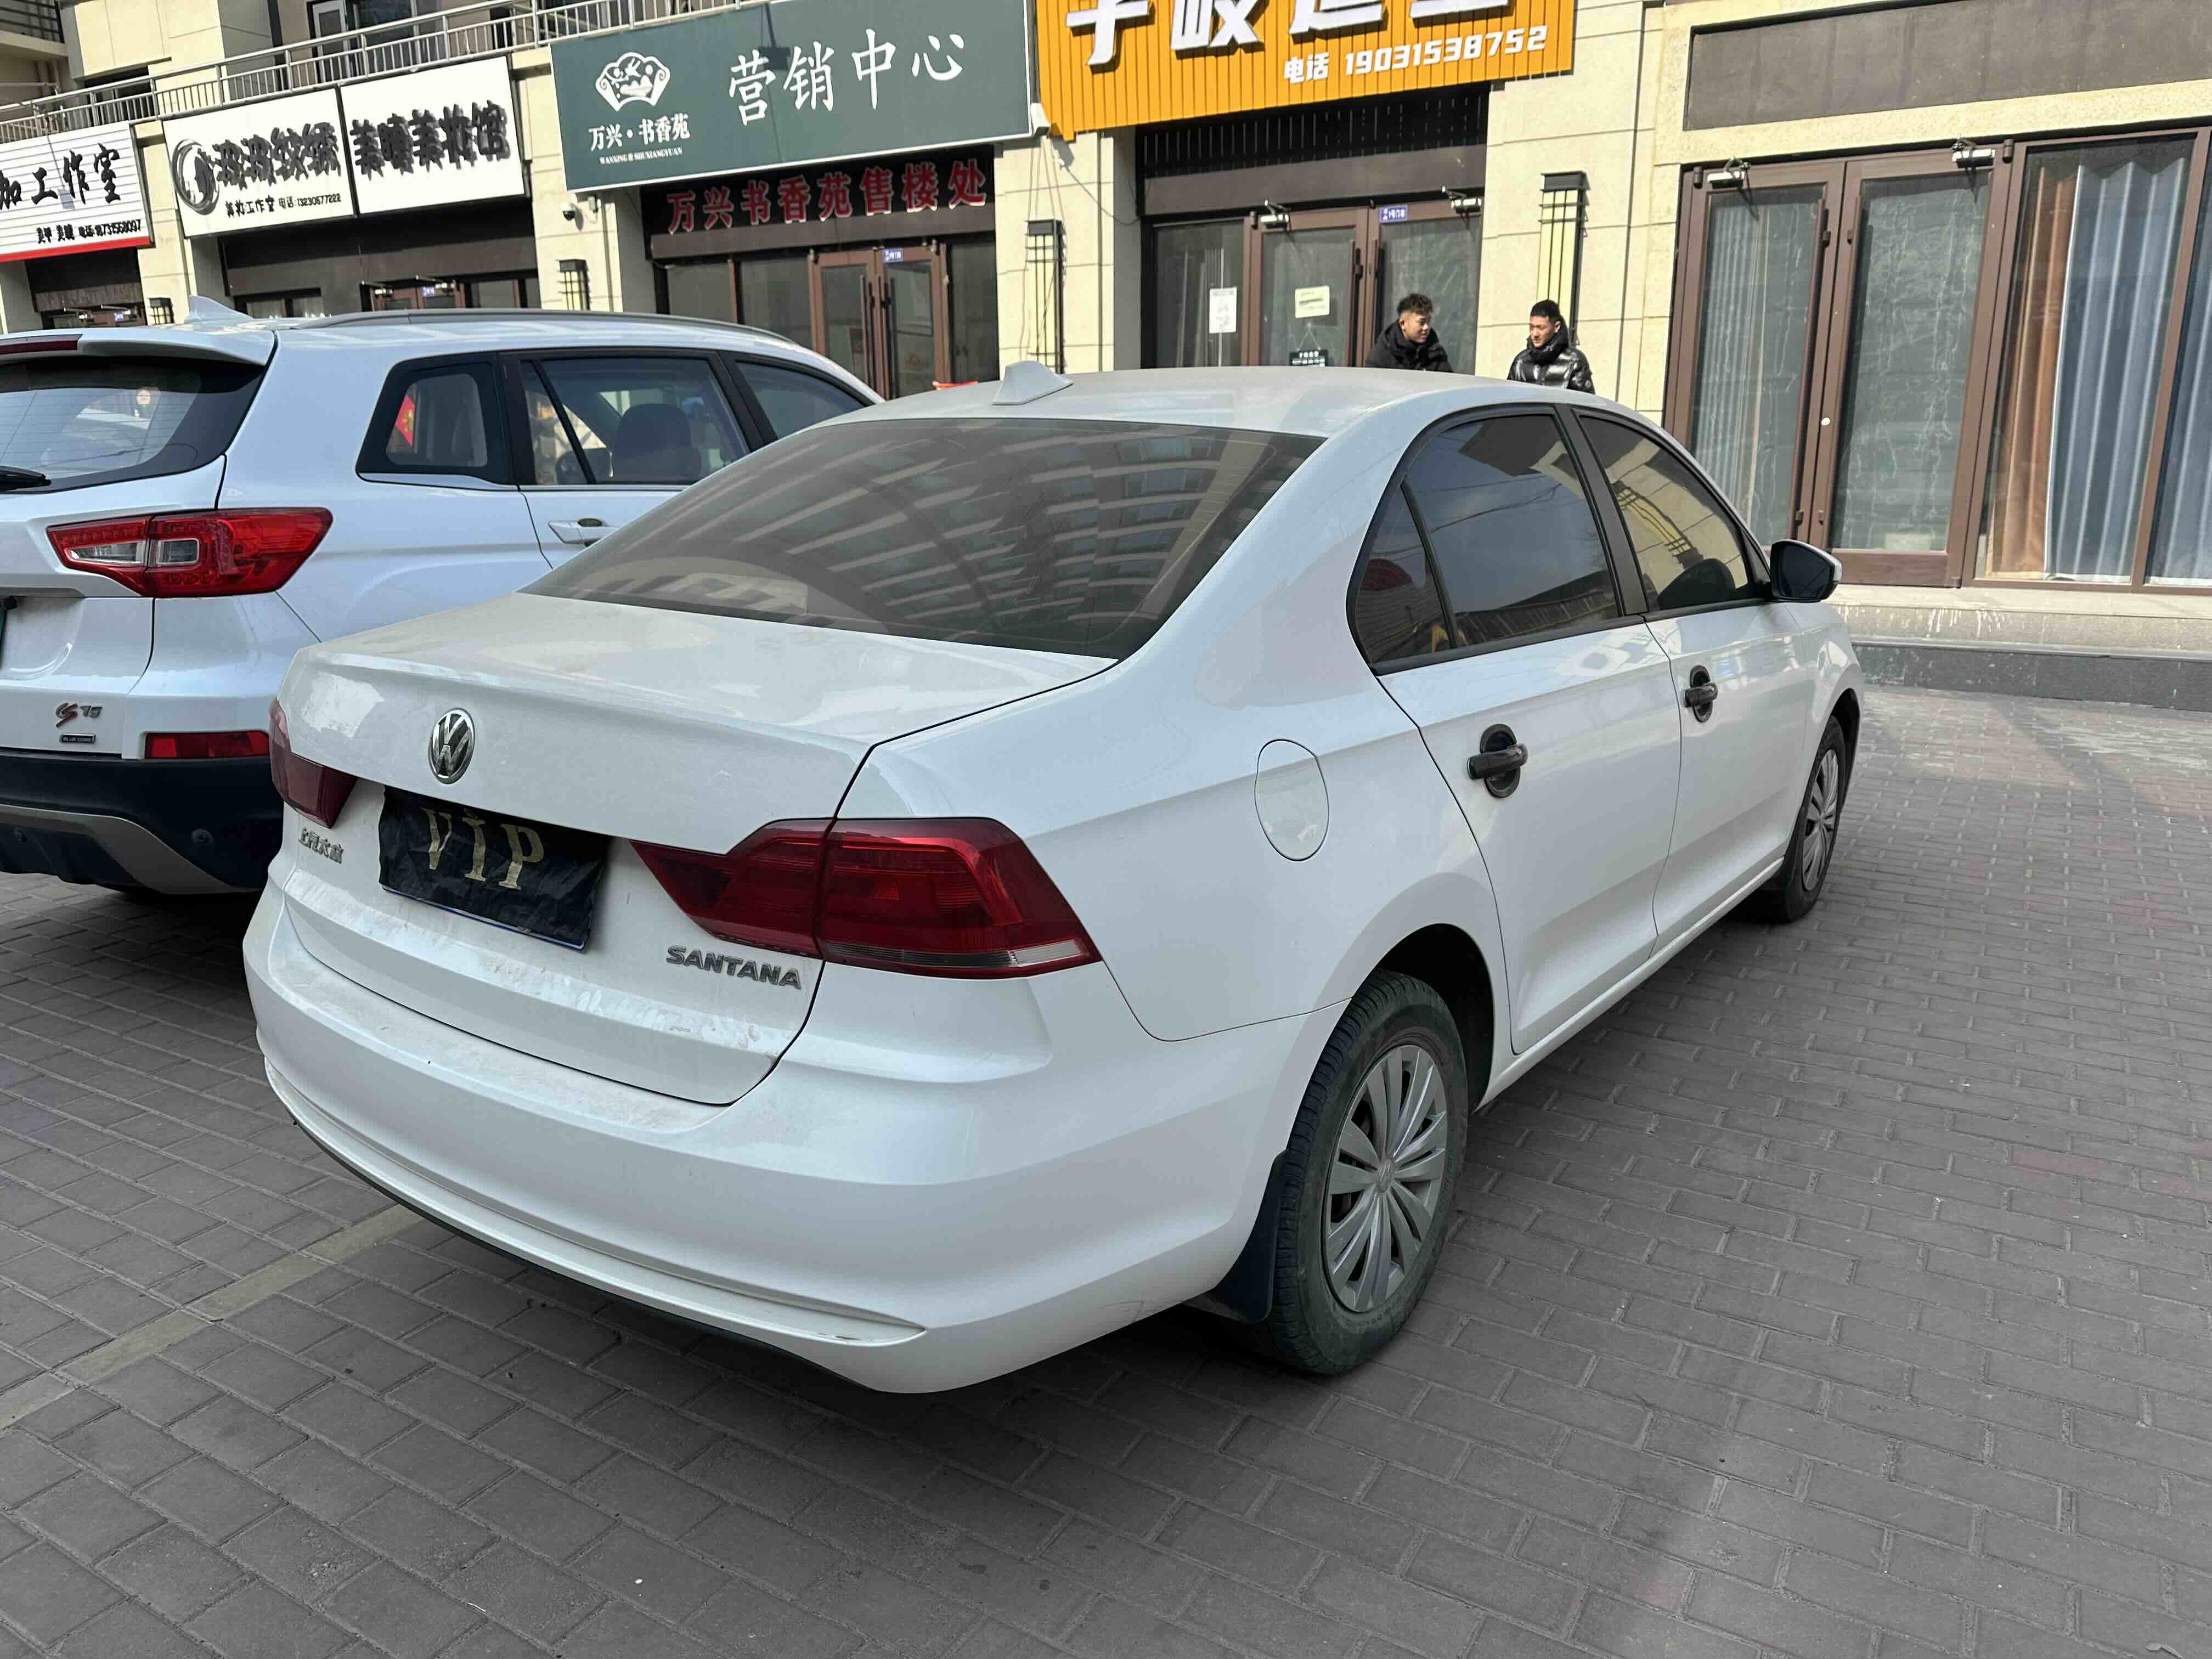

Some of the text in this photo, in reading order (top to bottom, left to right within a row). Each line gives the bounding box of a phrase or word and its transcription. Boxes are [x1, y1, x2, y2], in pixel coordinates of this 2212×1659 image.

[729, 28, 965, 127] 营销中心
[1283, 25, 1548, 84] 电话 19031538752
[667, 158, 987, 235] 万兴书香苑售楼处
[420, 806, 545, 891] VIP
[665, 944, 802, 990] SANTANA
